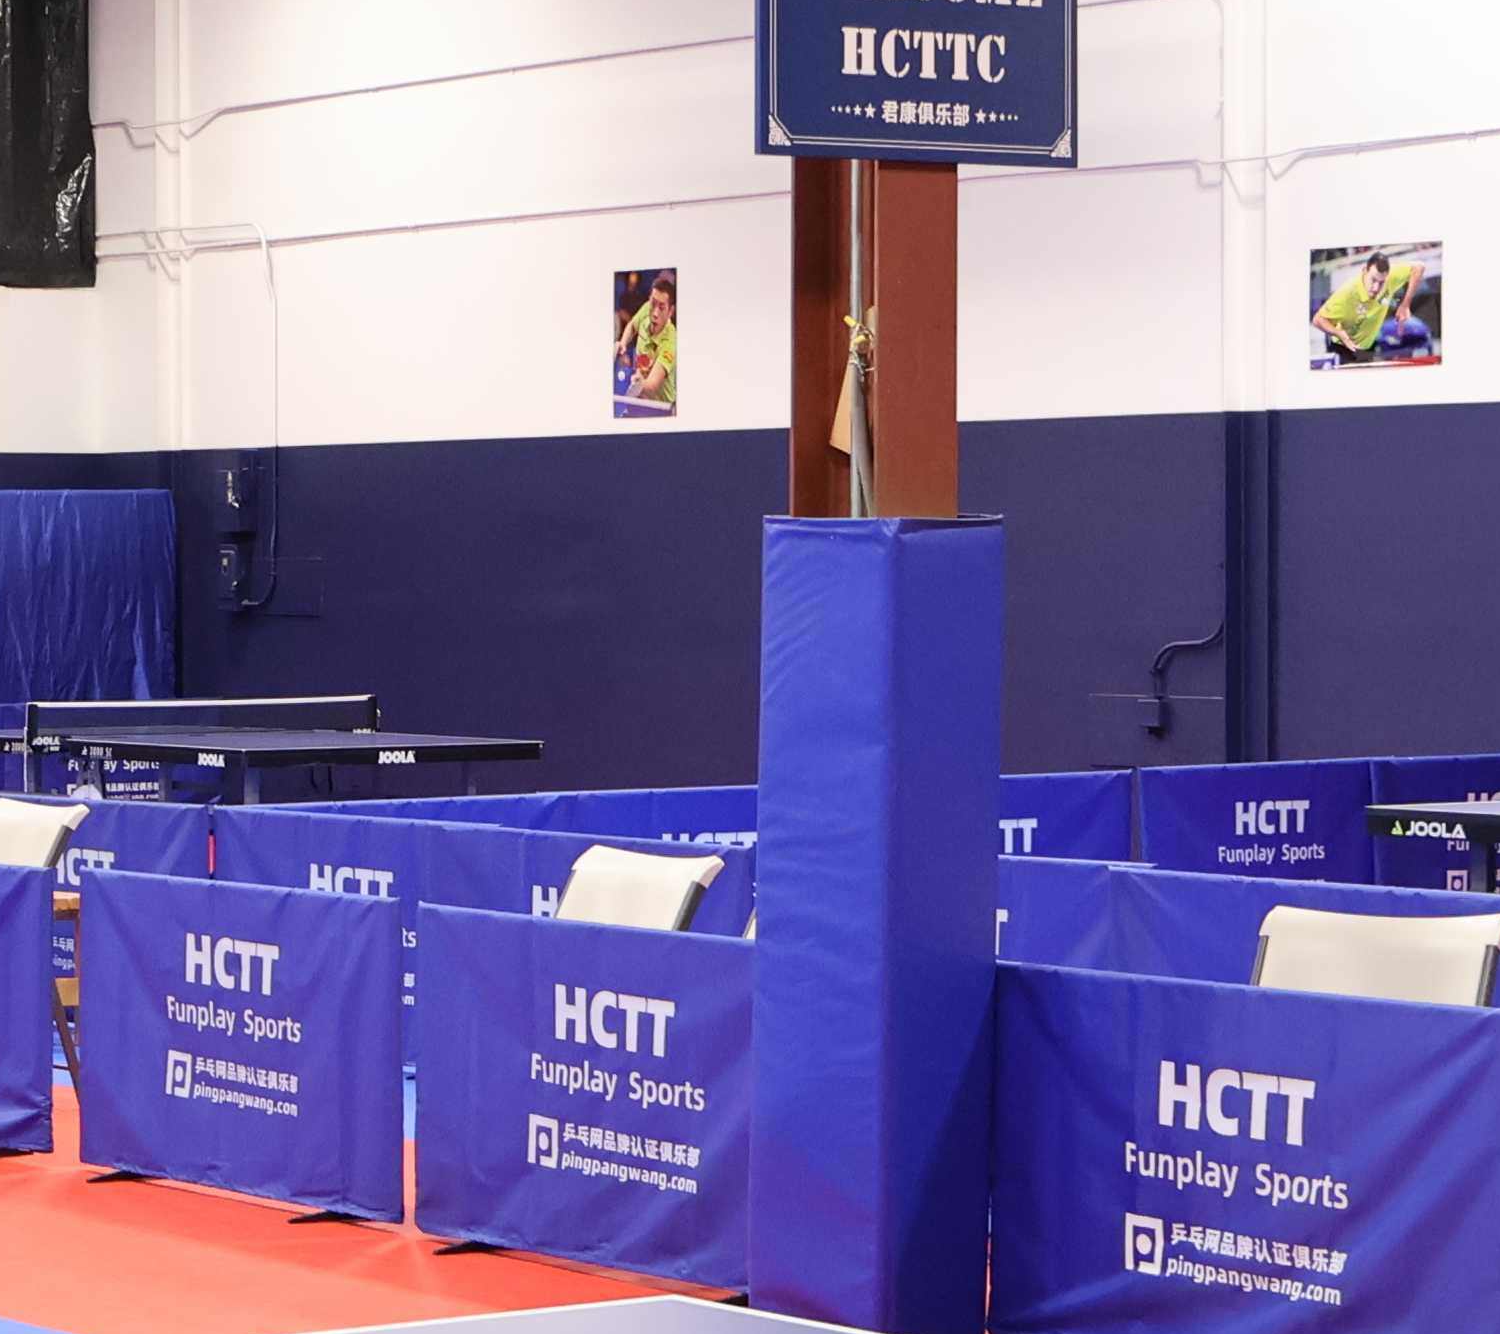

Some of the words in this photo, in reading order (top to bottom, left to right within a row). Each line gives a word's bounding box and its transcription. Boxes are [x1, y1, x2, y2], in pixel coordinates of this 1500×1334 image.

[841, 26, 1006, 83] HCTTC
[881, 100, 970, 126] 君康俱乐部
[198, 753, 225, 767] JOOLA
[378, 750, 416, 764] JOOLA
[1235, 799, 1310, 835] HCTT
[1405, 821, 1467, 839] JOOLA
[1218, 844, 1276, 866] Funplay
[1281, 842, 1325, 863] Sports
[185, 932, 280, 996] HCTT
[166, 995, 236, 1037] Funplay
[243, 1009, 302, 1044] Sports
[554, 983, 676, 1058] HCTT
[193, 1081, 298, 1117] pingpangwang.com
[530, 1052, 618, 1102] Funplay
[629, 1072, 706, 1112] Sports
[1158, 1060, 1316, 1147] HCTT
[562, 1122, 701, 1167] 乒乓网品牌认证俱乐部
[561, 1152, 697, 1194] pingpangwang.com
[1125, 1141, 1239, 1198] Funplay
[1255, 1163, 1349, 1210] Sports
[1170, 1222, 1348, 1276] 乒乓网品牌认证俱乐部
[1166, 1255, 1342, 1306] pingpangwang.com
